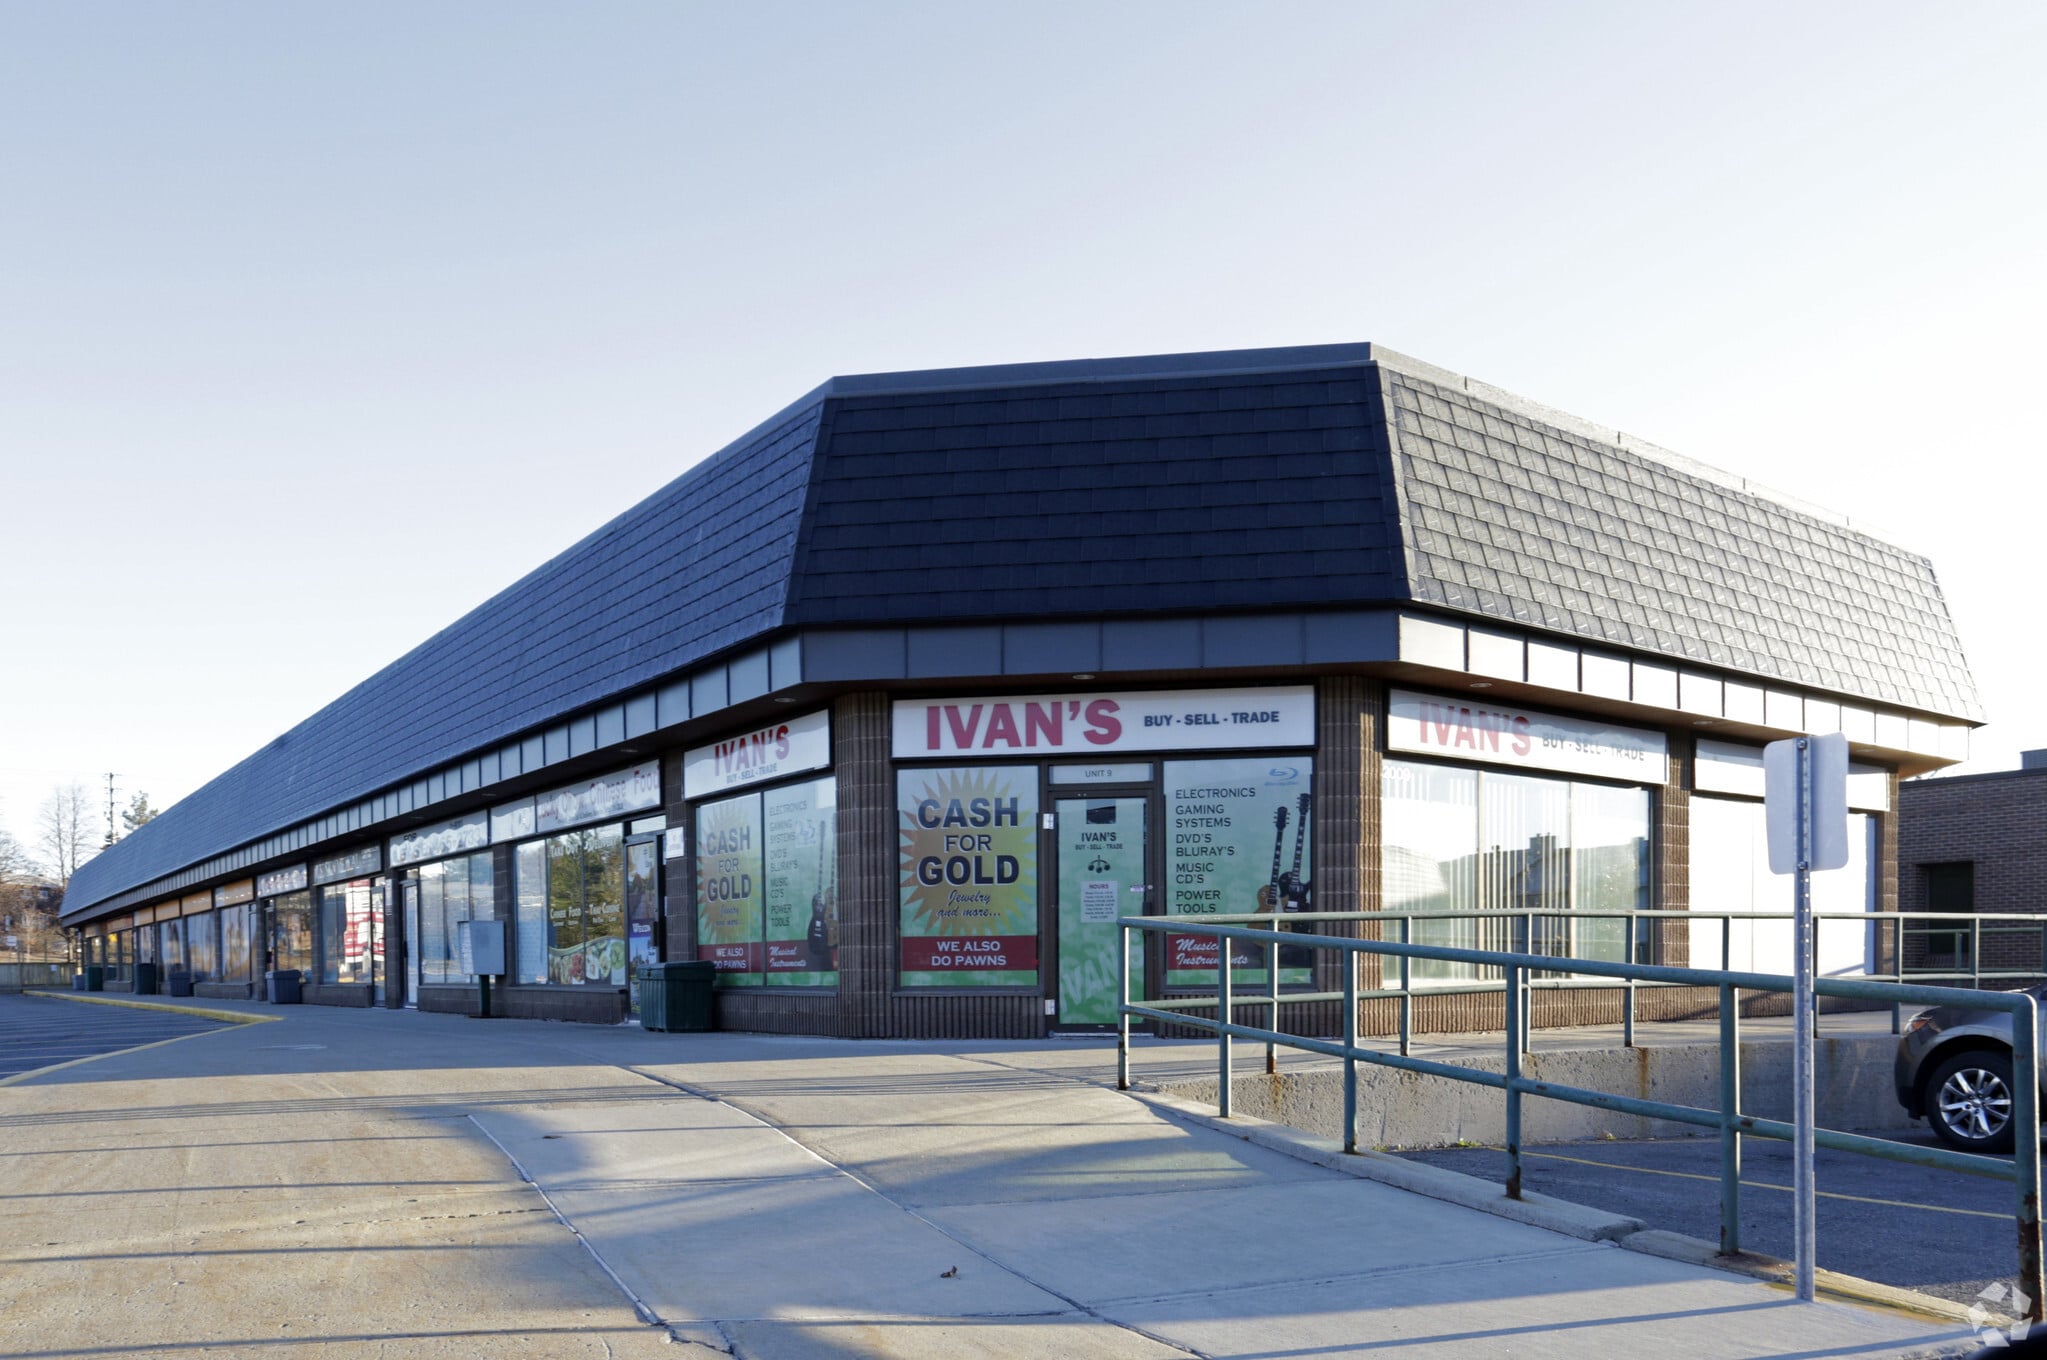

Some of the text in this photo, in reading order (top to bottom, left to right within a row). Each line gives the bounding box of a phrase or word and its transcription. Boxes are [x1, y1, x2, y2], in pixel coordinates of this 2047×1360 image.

[927, 699, 1122, 750] IVAN'S
[1144, 714, 1173, 727] BUY
[1184, 713, 1220, 726] SELL
[1231, 711, 1280, 724] TRADE
[1419, 701, 1531, 757] IVAN'S
[714, 725, 790, 777] IVAN'S
[1542, 731, 1565, 750] BUY
[1575, 736, 1601, 755] SELL
[1610, 742, 1645, 761] TRADE
[741, 769, 756, 780] SELL
[1176, 788, 1256, 799] ELECTRONICS
[917, 797, 1018, 829] CASH
[1176, 804, 1224, 815] GAMING
[1176, 817, 1231, 828] SYSTEMS
[706, 825, 751, 855] CASH
[1081, 832, 1117, 842] IVAN'S
[1176, 833, 1212, 843] DVD'S
[944, 834, 992, 853] FOR
[1176, 846, 1235, 857] BLURAY'S
[719, 858, 739, 873] FOR
[917, 855, 1020, 887] GOLD
[1176, 863, 1214, 873] MUSIC
[1176, 874, 1204, 884] CD'S
[706, 874, 752, 902] GOLD
[948, 889, 990, 906] Jewelry
[1176, 890, 1221, 900] POWER
[936, 907, 958, 919] and
[1176, 904, 1216, 914] TOOLS
[937, 940, 1000, 951] WE ALSO
[1176, 939, 1220, 951] Music
[716, 947, 744, 957] WE ALSO
[723, 960, 746, 969] PAWNS
[931, 955, 1007, 966] DO PAWNS
